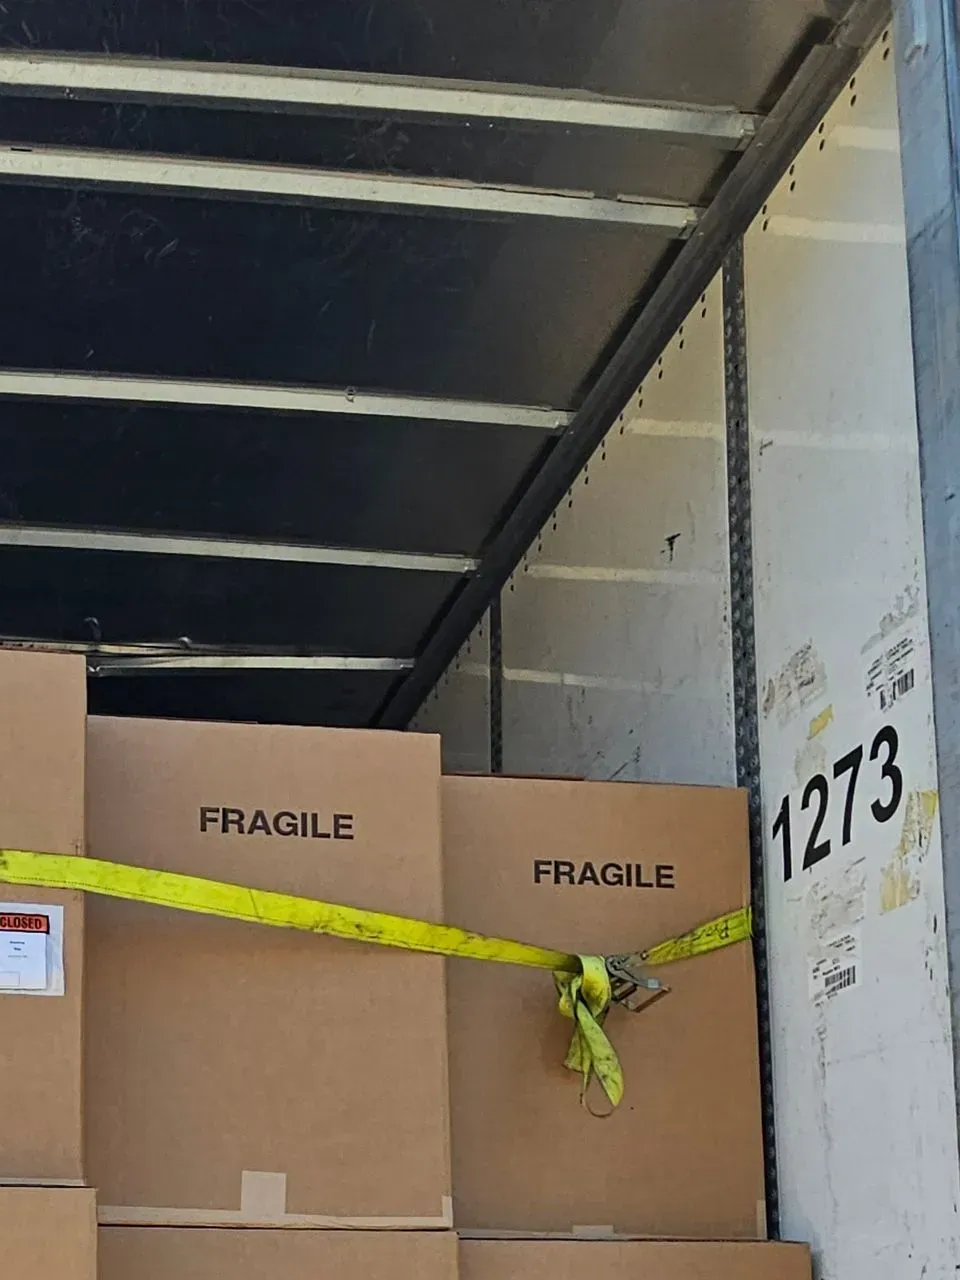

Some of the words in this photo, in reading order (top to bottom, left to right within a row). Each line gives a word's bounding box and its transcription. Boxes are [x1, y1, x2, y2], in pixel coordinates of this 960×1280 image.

[772, 725, 903, 883] 1273
[201, 806, 354, 841] FRAGILE
[535, 859, 675, 889] FRAGILE
